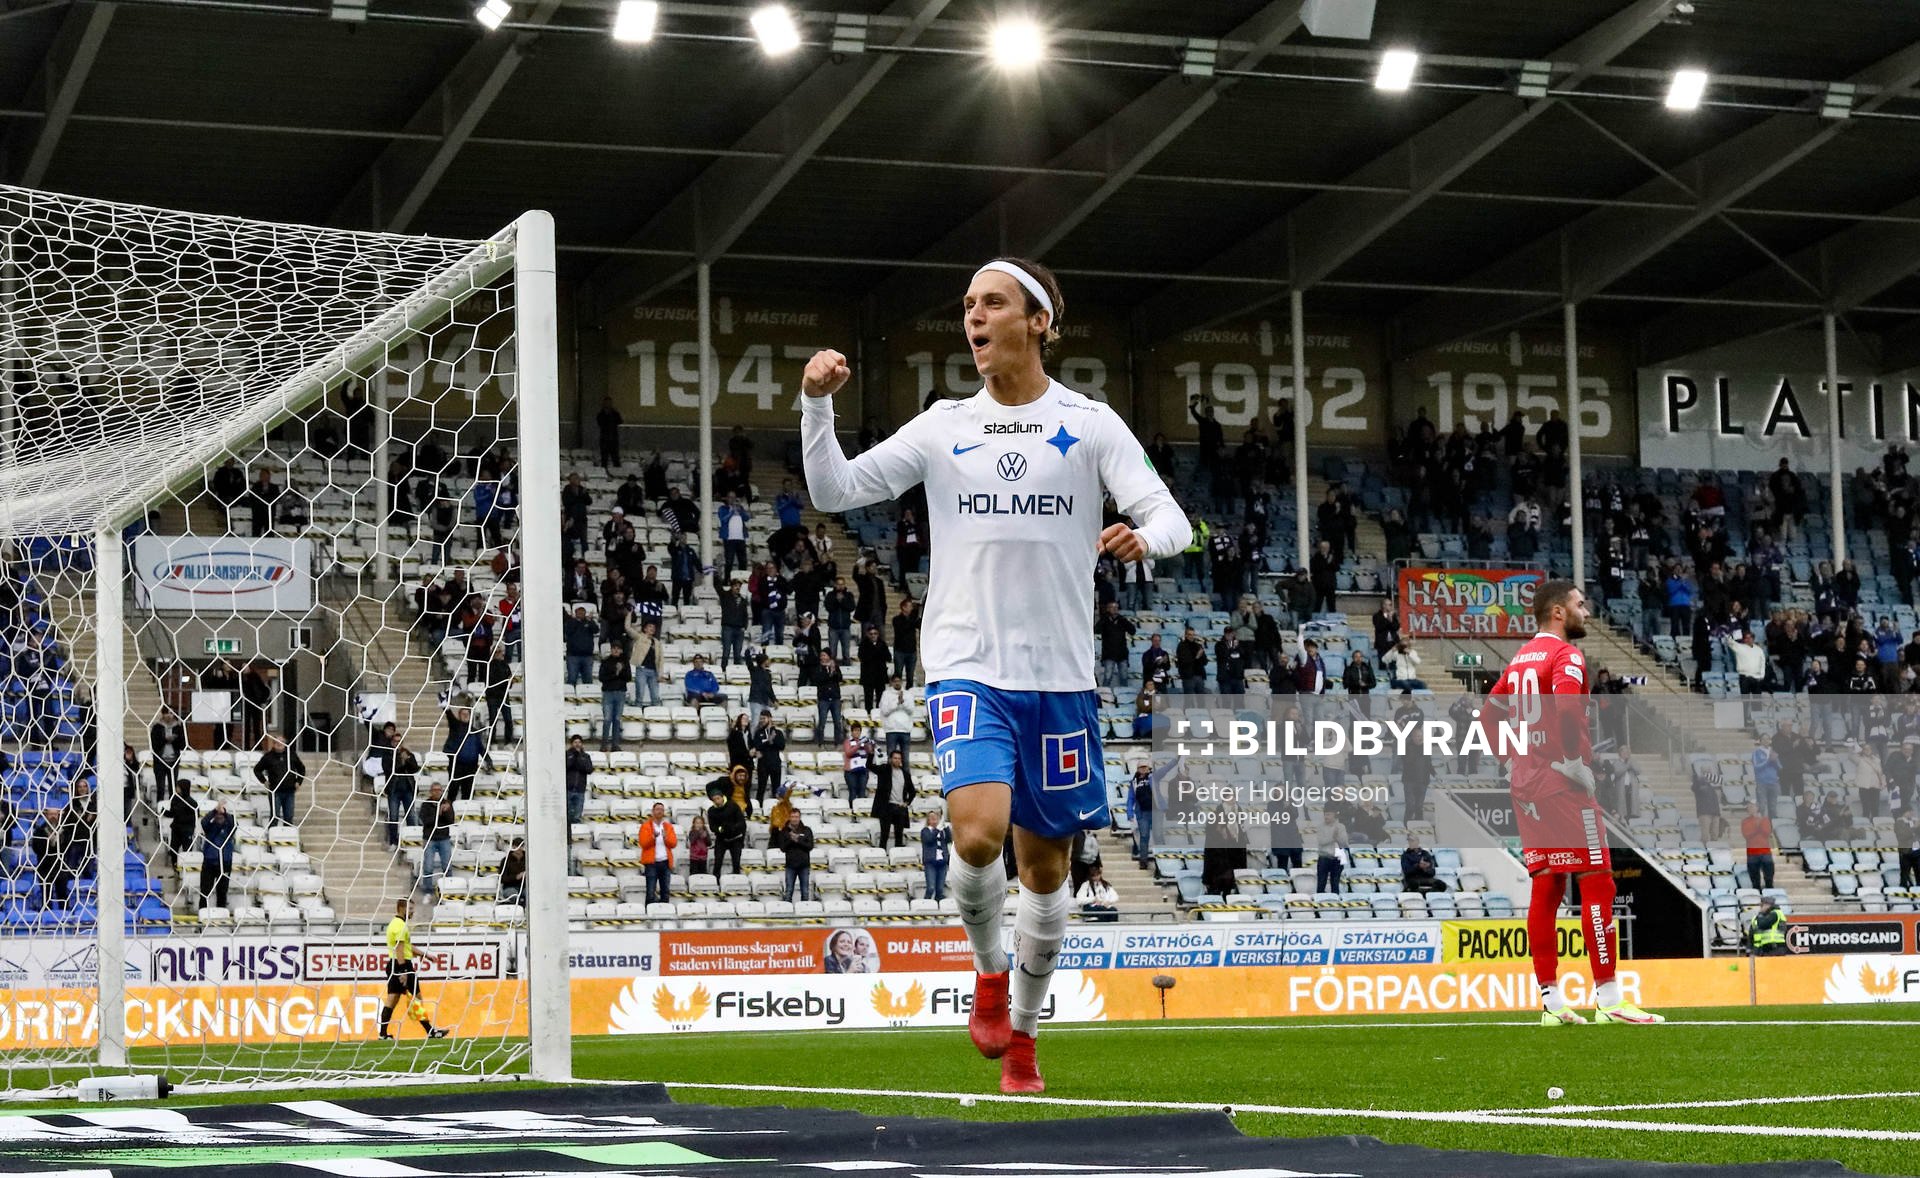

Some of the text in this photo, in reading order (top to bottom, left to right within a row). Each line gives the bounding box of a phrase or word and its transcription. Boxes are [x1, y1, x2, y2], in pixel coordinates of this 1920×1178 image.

[632, 307, 699, 321] SVENSK
[1284, 334, 1351, 348] MSTARE
[905, 351, 1108, 412] 198
[1174, 361, 1367, 430] 1952
[1427, 370, 1612, 438] 1956
[984, 421, 1043, 434] stadium
[958, 493, 1073, 516] HOLMEN
[1408, 608, 1538, 633] MÅLERI AB
[1507, 668, 1542, 728] 30
[938, 749, 956, 777] 10
[1125, 932, 1214, 949] STÅTHÖGA
[1234, 930, 1323, 947] STÅTHÖGA
[1343, 927, 1428, 944] STÅTHÖGA
[1590, 904, 1610, 965] BRÖDERNAS
[1796, 931, 1900, 947] HYDROSCAND
[669, 941, 804, 956] Tillsammans skapar vi
[887, 941, 909, 954] DU
[911, 937, 932, 953] ÄR
[222, 945, 301, 982] HISS
[465, 952, 493, 970] AB
[669, 954, 816, 972] staden vi längtar hem till.
[1084, 954, 1103, 966] AB
[1122, 953, 1213, 967] VERKSTAD AB
[1231, 950, 1321, 964] VERKSTAD AB
[1340, 949, 1428, 962] VERKSTAD AB
[1289, 967, 1642, 1012] FÖRPACKNIGR
[715, 989, 845, 1025] Fiskeby
